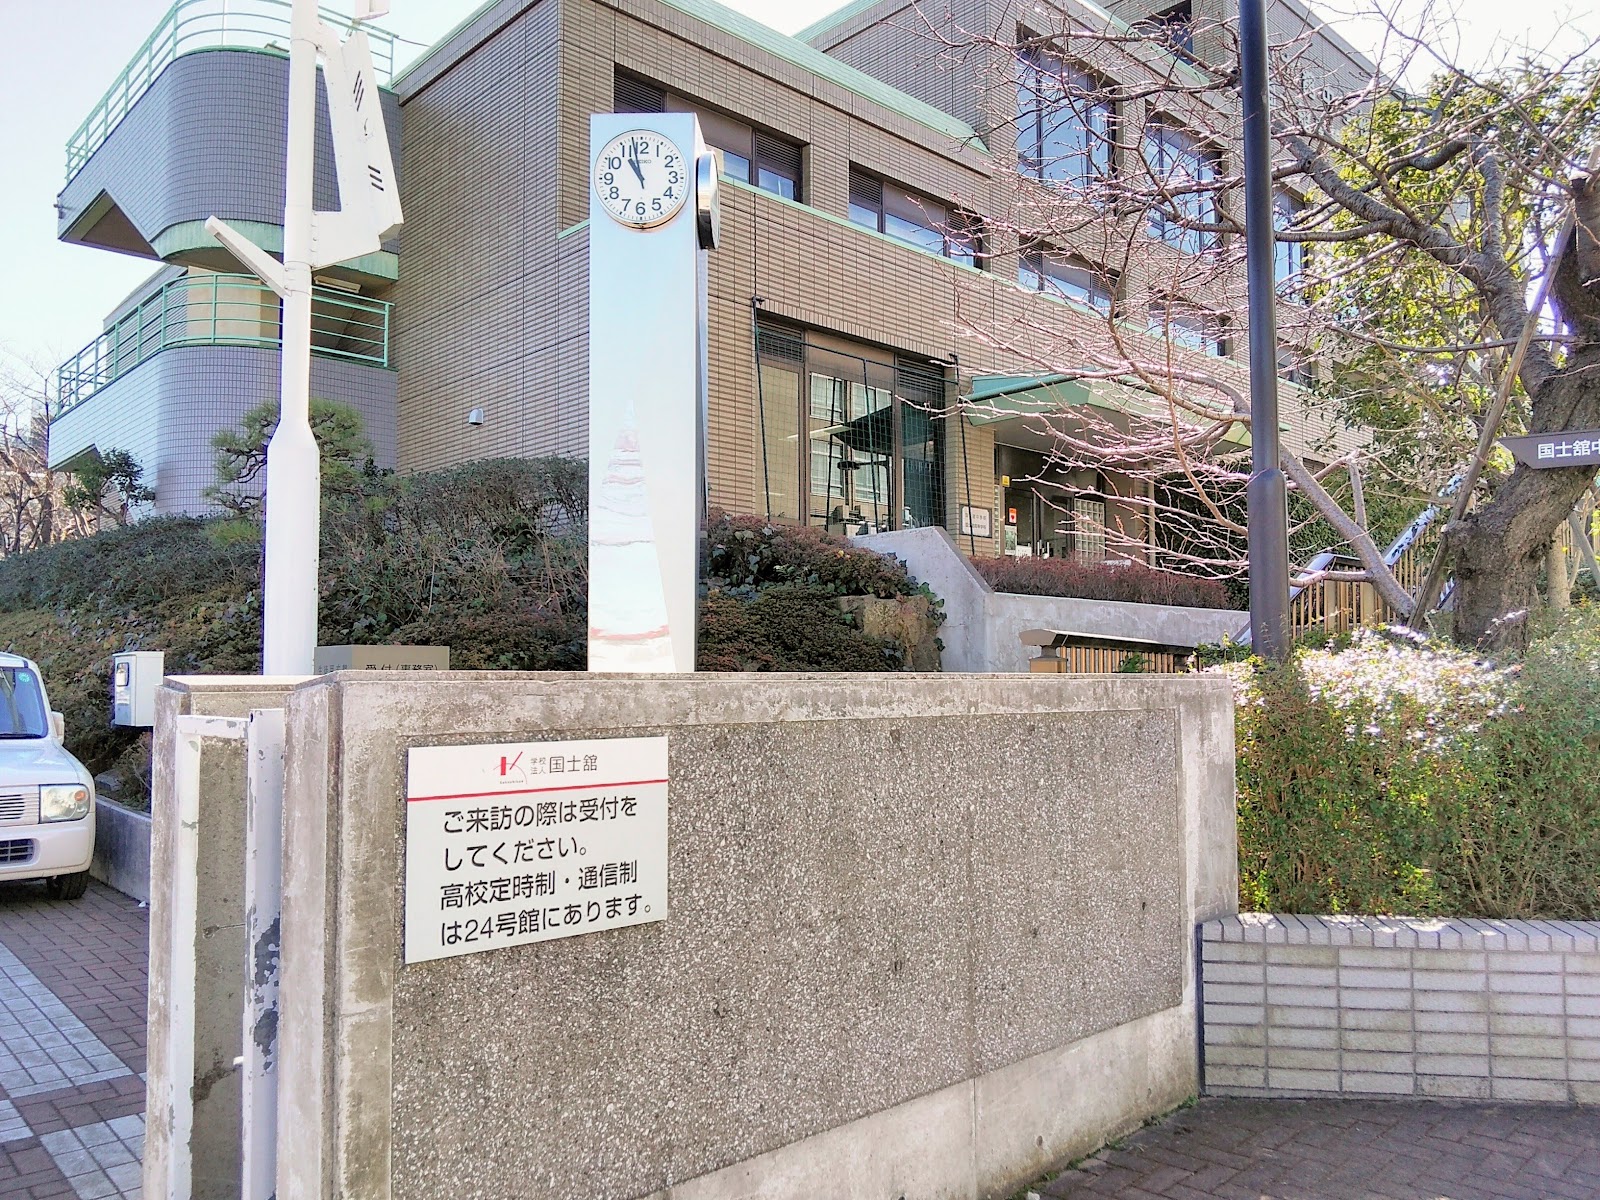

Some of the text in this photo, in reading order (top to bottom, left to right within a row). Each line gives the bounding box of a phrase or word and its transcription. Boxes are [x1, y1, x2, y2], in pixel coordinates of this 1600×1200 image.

[621, 144, 632, 158] 11
[635, 141, 649, 155] 12
[656, 144, 660, 157] 1
[608, 156, 622, 170] 10
[664, 155, 674, 168] 2
[603, 172, 614, 185] 9
[668, 171, 678, 184] 3
[609, 186, 619, 200] 8
[663, 186, 674, 199] 4
[621, 199, 632, 212] 7
[635, 202, 646, 215] 6
[651, 198, 662, 211] 5
[443, 795, 638, 834] ご来訪の際は受付を
[443, 837, 587, 871] してください。
[440, 859, 638, 911] 高校定時制・通信制
[440, 893, 652, 947] は24号館にあります。
